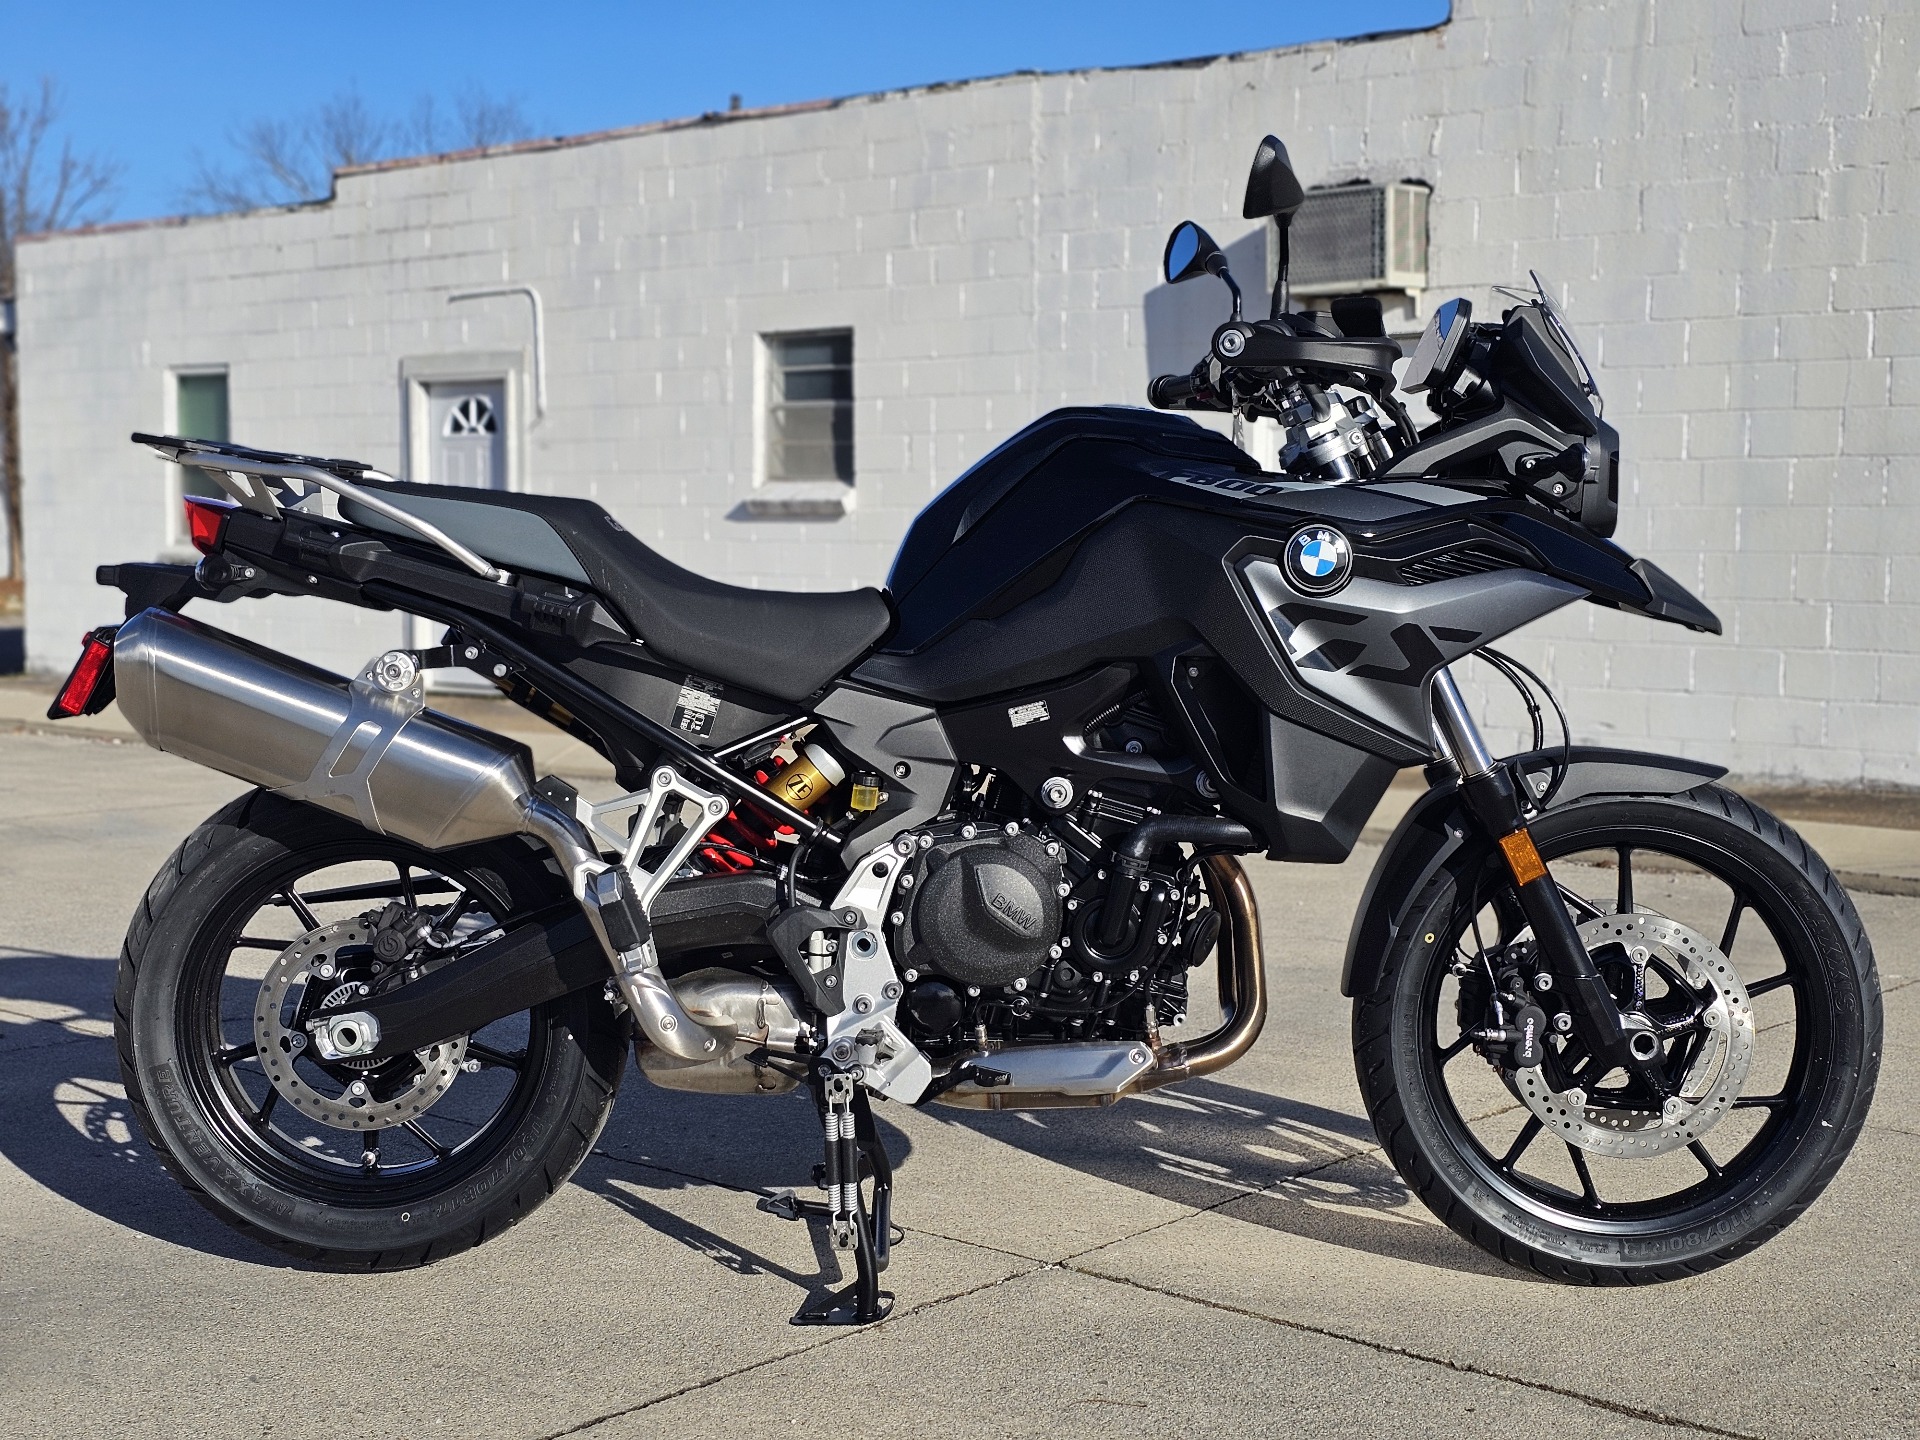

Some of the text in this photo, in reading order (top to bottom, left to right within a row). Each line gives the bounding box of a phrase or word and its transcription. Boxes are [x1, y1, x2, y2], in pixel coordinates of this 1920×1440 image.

[1298, 531, 1346, 554] BM
[785, 774, 813, 799] ZF
[992, 892, 1037, 929] BMW
[1523, 1017, 1534, 1058] brembo
[155, 1067, 290, 1218] MAXXVENTURE
[433, 1119, 546, 1218] 150/70R17
